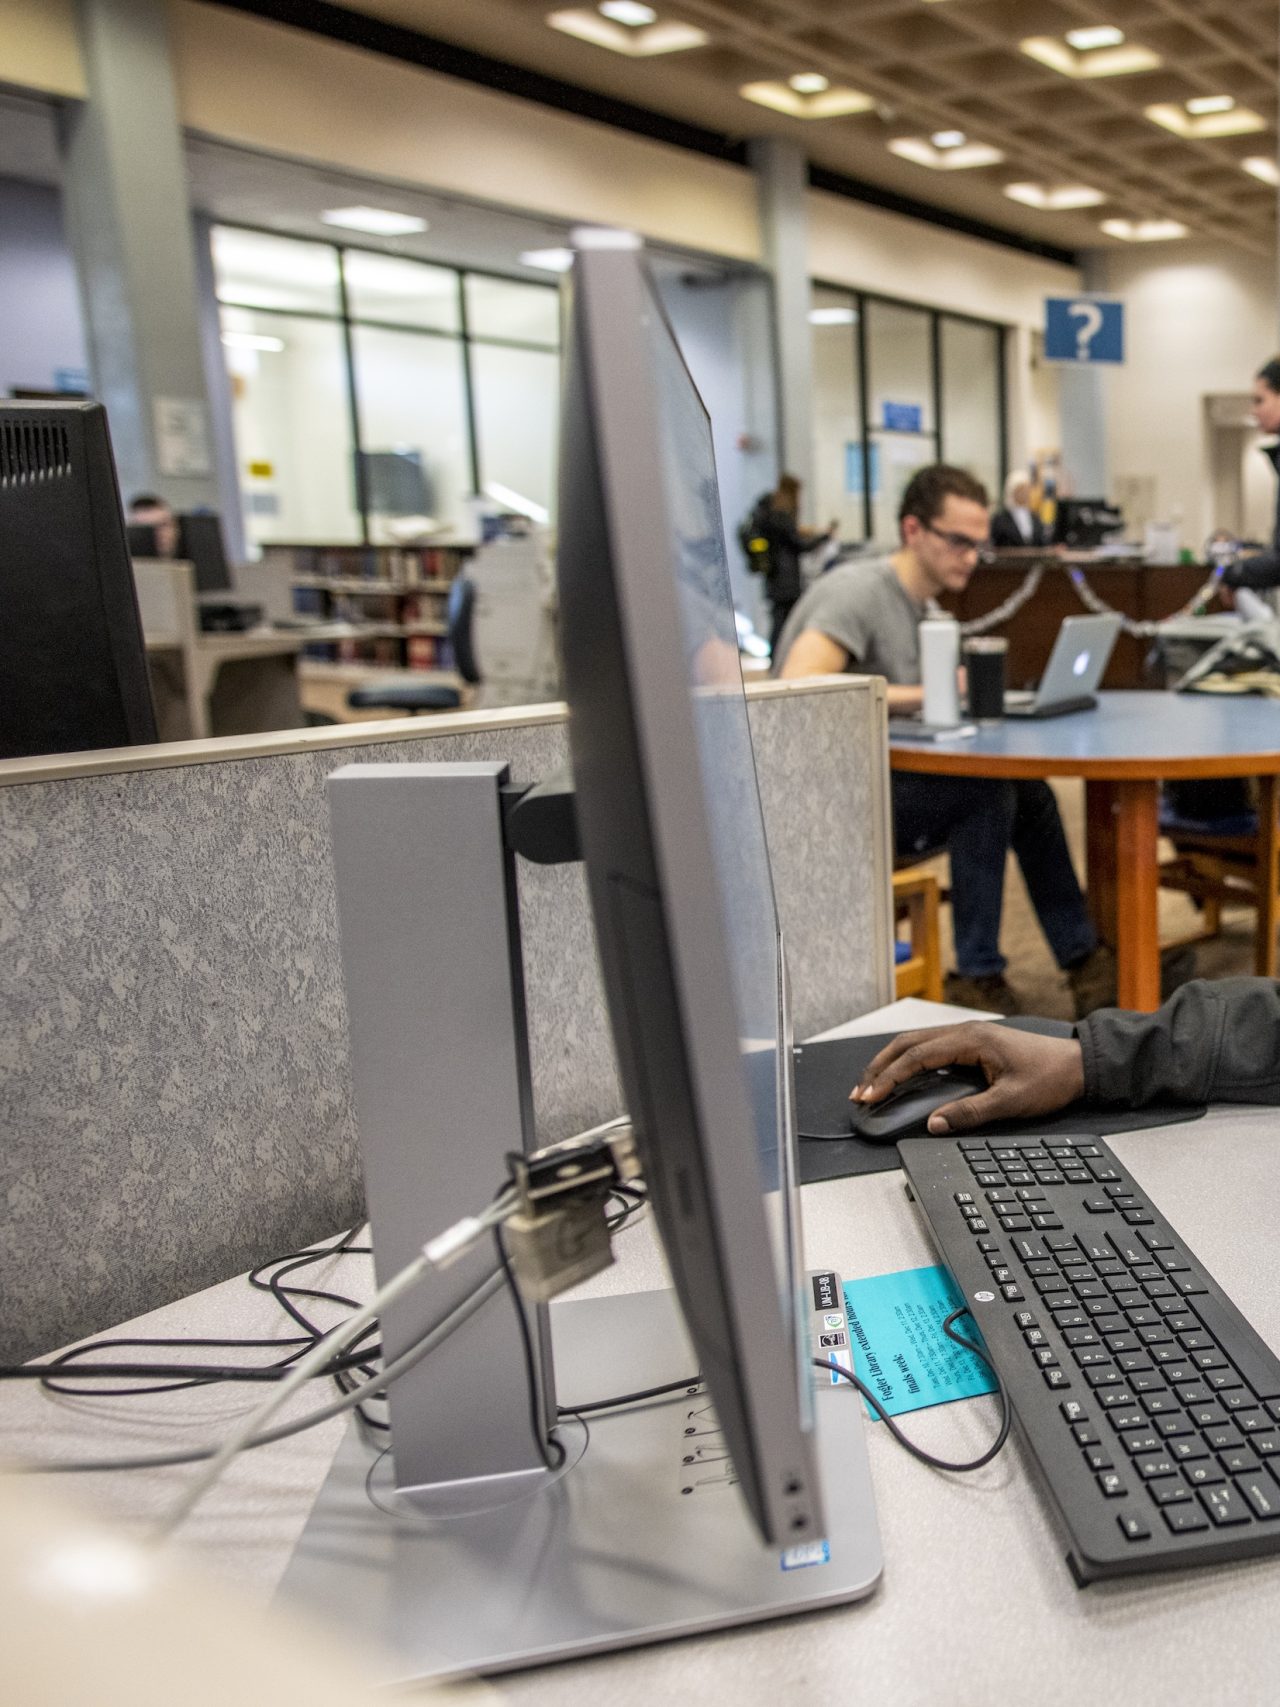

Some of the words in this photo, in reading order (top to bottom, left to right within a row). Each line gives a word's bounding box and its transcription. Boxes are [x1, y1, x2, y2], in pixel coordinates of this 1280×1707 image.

[1067, 304, 1103, 360] ?
[819, 1276, 833, 1307] UM-LIB-08
[845, 1301, 857, 1321] hours
[852, 1320, 871, 1351] extended
[865, 1352, 882, 1377] Library
[893, 1353, 910, 1373] week:
[876, 1377, 894, 1401] Fogler
[903, 1373, 920, 1394] finals
[1179, 1445, 1190, 1454] W
